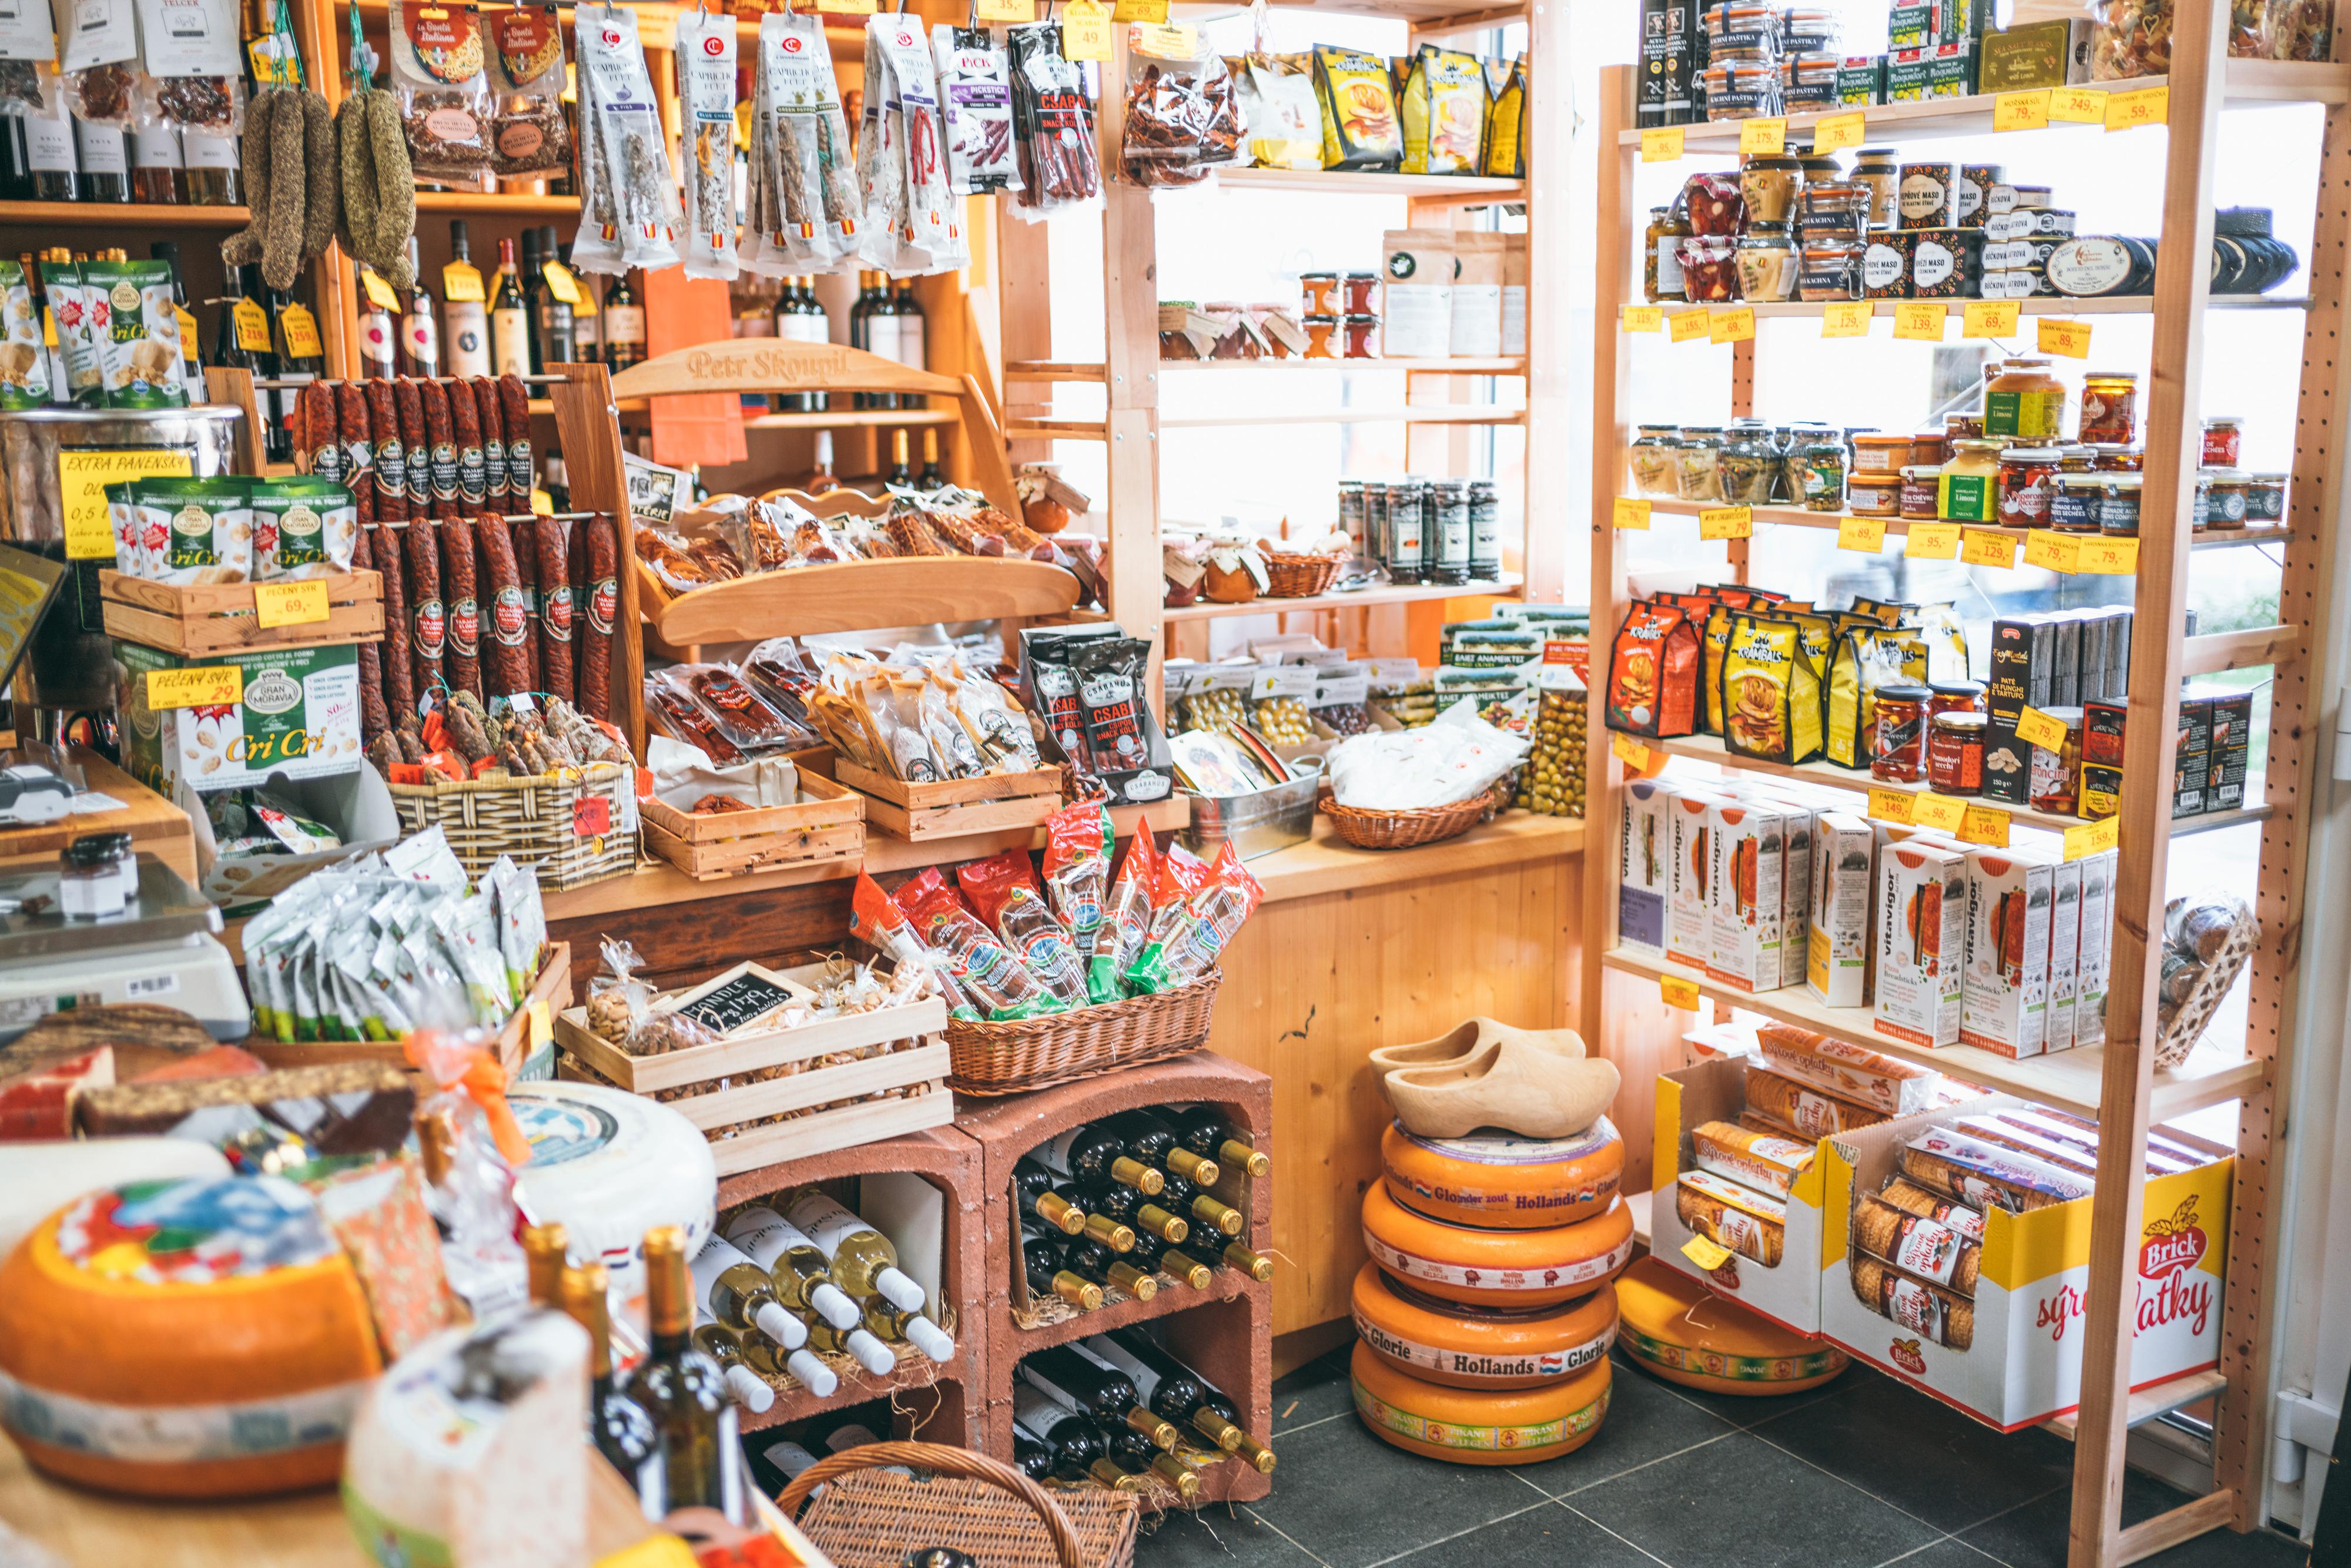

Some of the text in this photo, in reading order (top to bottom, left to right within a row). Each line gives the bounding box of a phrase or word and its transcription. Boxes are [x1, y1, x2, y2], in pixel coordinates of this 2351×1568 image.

[1890, 14, 1926, 27] Roquefort
[421, 31, 456, 43] Italiana
[507, 39, 538, 48] Italiana
[1728, 33, 1756, 42] PAŠTIKA
[1790, 38, 1817, 47] PAŠTIKA
[1890, 70, 1927, 83] Roquefort
[1930, 65, 1965, 78] Roquefort
[1839, 76, 1874, 88] Roquefort
[970, 86, 1006, 95] PICKSTICK
[1796, 86, 1823, 95] PAŠTIKA
[1731, 93, 1758, 102] PAŠTIKA
[2004, 99, 2029, 108] MOŘSKÁ
[2109, 90, 2167, 105] TĚSTOVINY SRDÍČKA
[2069, 98, 2098, 113] 249,-
[2131, 105, 2154, 119] 59,-
[2015, 107, 2036, 121] 79,-
[1041, 119, 1063, 128] SNACK
[1756, 132, 1777, 145] 179,-
[1833, 130, 1851, 143] 79,-
[1922, 191, 1939, 199] MASO
[1636, 313, 1656, 326] 119,-
[1839, 316, 1863, 329] 129,-
[1911, 319, 1937, 332] 139,-
[1985, 316, 2007, 329] 69,-
[107, 323, 150, 340] Cri Cri
[1684, 320, 1704, 333] 155,-
[1727, 322, 1744, 333] 69,-
[2038, 323, 2056, 331] TUŇÁK
[2059, 333, 2078, 349] 89,-
[686, 347, 852, 386] Petr Skoupil
[1993, 410, 2012, 418] Limoni
[66, 457, 112, 471] EXTRA
[143, 497, 184, 505] FORMAGGIO
[217, 498, 241, 507] FORNO
[1912, 493, 1934, 501] CHÈVRE
[1955, 494, 1977, 502] Limoni
[71, 507, 95, 524] 0,5
[1857, 527, 1876, 541] 89,-
[1926, 536, 1947, 549] 95,-
[163, 549, 224, 565] Cri Cri
[272, 549, 331, 565] Cri Cri
[1983, 545, 2010, 562] 129,-
[2047, 546, 2067, 562] 79,-
[2102, 551, 2124, 565] 79,-
[266, 583, 317, 597] PEČENÝ SÝR
[285, 599, 312, 613] 69,-
[223, 654, 263, 665] FORMAGGIO
[263, 653, 284, 662] COTTO
[293, 649, 316, 659] FORNO
[1477, 655, 1525, 664] ΑΝΑΜΕΙΚΤΕΣ
[1737, 646, 1783, 664] KRAMBALS
[156, 669, 233, 689] PEČENÝ SÝR
[260, 684, 286, 695] GRAN
[1087, 678, 1131, 697] CSABANUS
[2000, 684, 2024, 693] FUNGHI
[253, 692, 294, 706] MORAVIA
[1996, 689, 2025, 700] TARTUFO
[1096, 730, 1118, 741] SNACK
[2039, 723, 2056, 741] 79,-
[225, 726, 328, 763] Cri Cri
[1932, 752, 1961, 764] Pomodori
[1935, 762, 1954, 771] secchi
[1129, 780, 1166, 792] CSABANUS
[1879, 792, 1909, 804] PAPRIČKY
[1884, 802, 1910, 817] 149,-
[1932, 806, 1952, 821] 98,-
[1840, 830, 1870, 839] vitavigor
[1978, 823, 2004, 839] 149,-
[1623, 800, 1632, 878] vitavigor
[2090, 830, 2116, 847] 159,-
[1674, 814, 1683, 894] vitavigor
[1713, 825, 1722, 908] vitavigor
[1943, 859, 1965, 867] vitavigor
[2028, 868, 2050, 877] vitavigor
[1884, 867, 1895, 957] vitavigor
[1967, 875, 1978, 965] vitavigor
[1884, 962, 1900, 974] Pizza
[1884, 970, 1918, 987] Breadsticks
[1965, 970, 1982, 983] Pizza
[1965, 979, 2001, 996] Breadsticks
[682, 979, 749, 1018] MANDLE
[1764, 1037, 1834, 1078] Sýrové oplatky
[1700, 1138, 1773, 1182] Sýrové oplatky
[1486, 1193, 1576, 1209] zout Hollands
[1904, 1230, 1928, 1267] Sýrové
[1919, 1226, 1945, 1274] oplatky
[2145, 1232, 2199, 1268] Brick
[1371, 1329, 1605, 1376] Glorie Hollands Glorie
[1894, 1347, 1923, 1374] Brick
[1449, 1428, 1488, 1439] PIKANT
[1520, 1434, 1562, 1446] BELEGEN
[1445, 1437, 1491, 1448] BELEGEN
